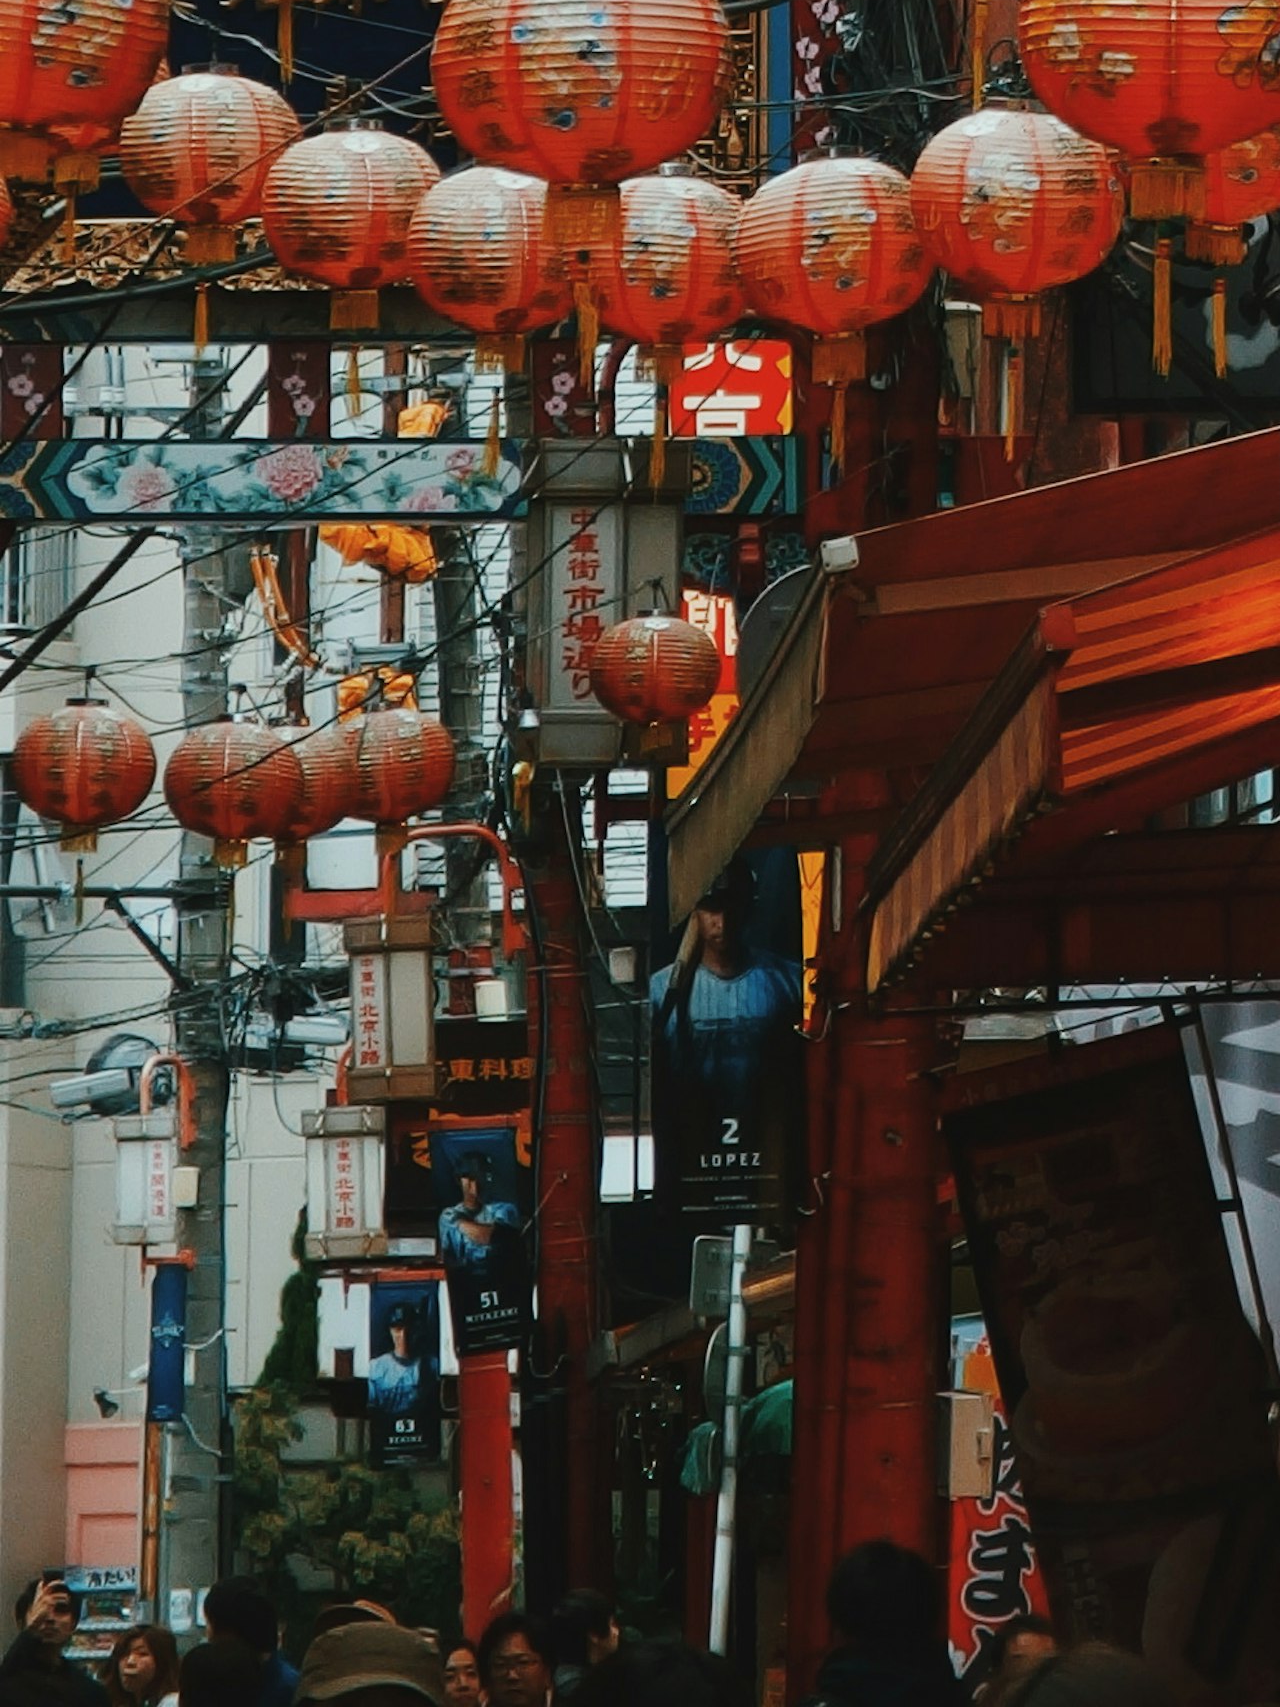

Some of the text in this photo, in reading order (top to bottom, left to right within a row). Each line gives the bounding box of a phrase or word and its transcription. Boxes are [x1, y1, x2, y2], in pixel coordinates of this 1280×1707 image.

[721, 1118, 739, 1144] 2
[700, 1152, 761, 1168] LOPEZ
[479, 1290, 500, 1309] 51
